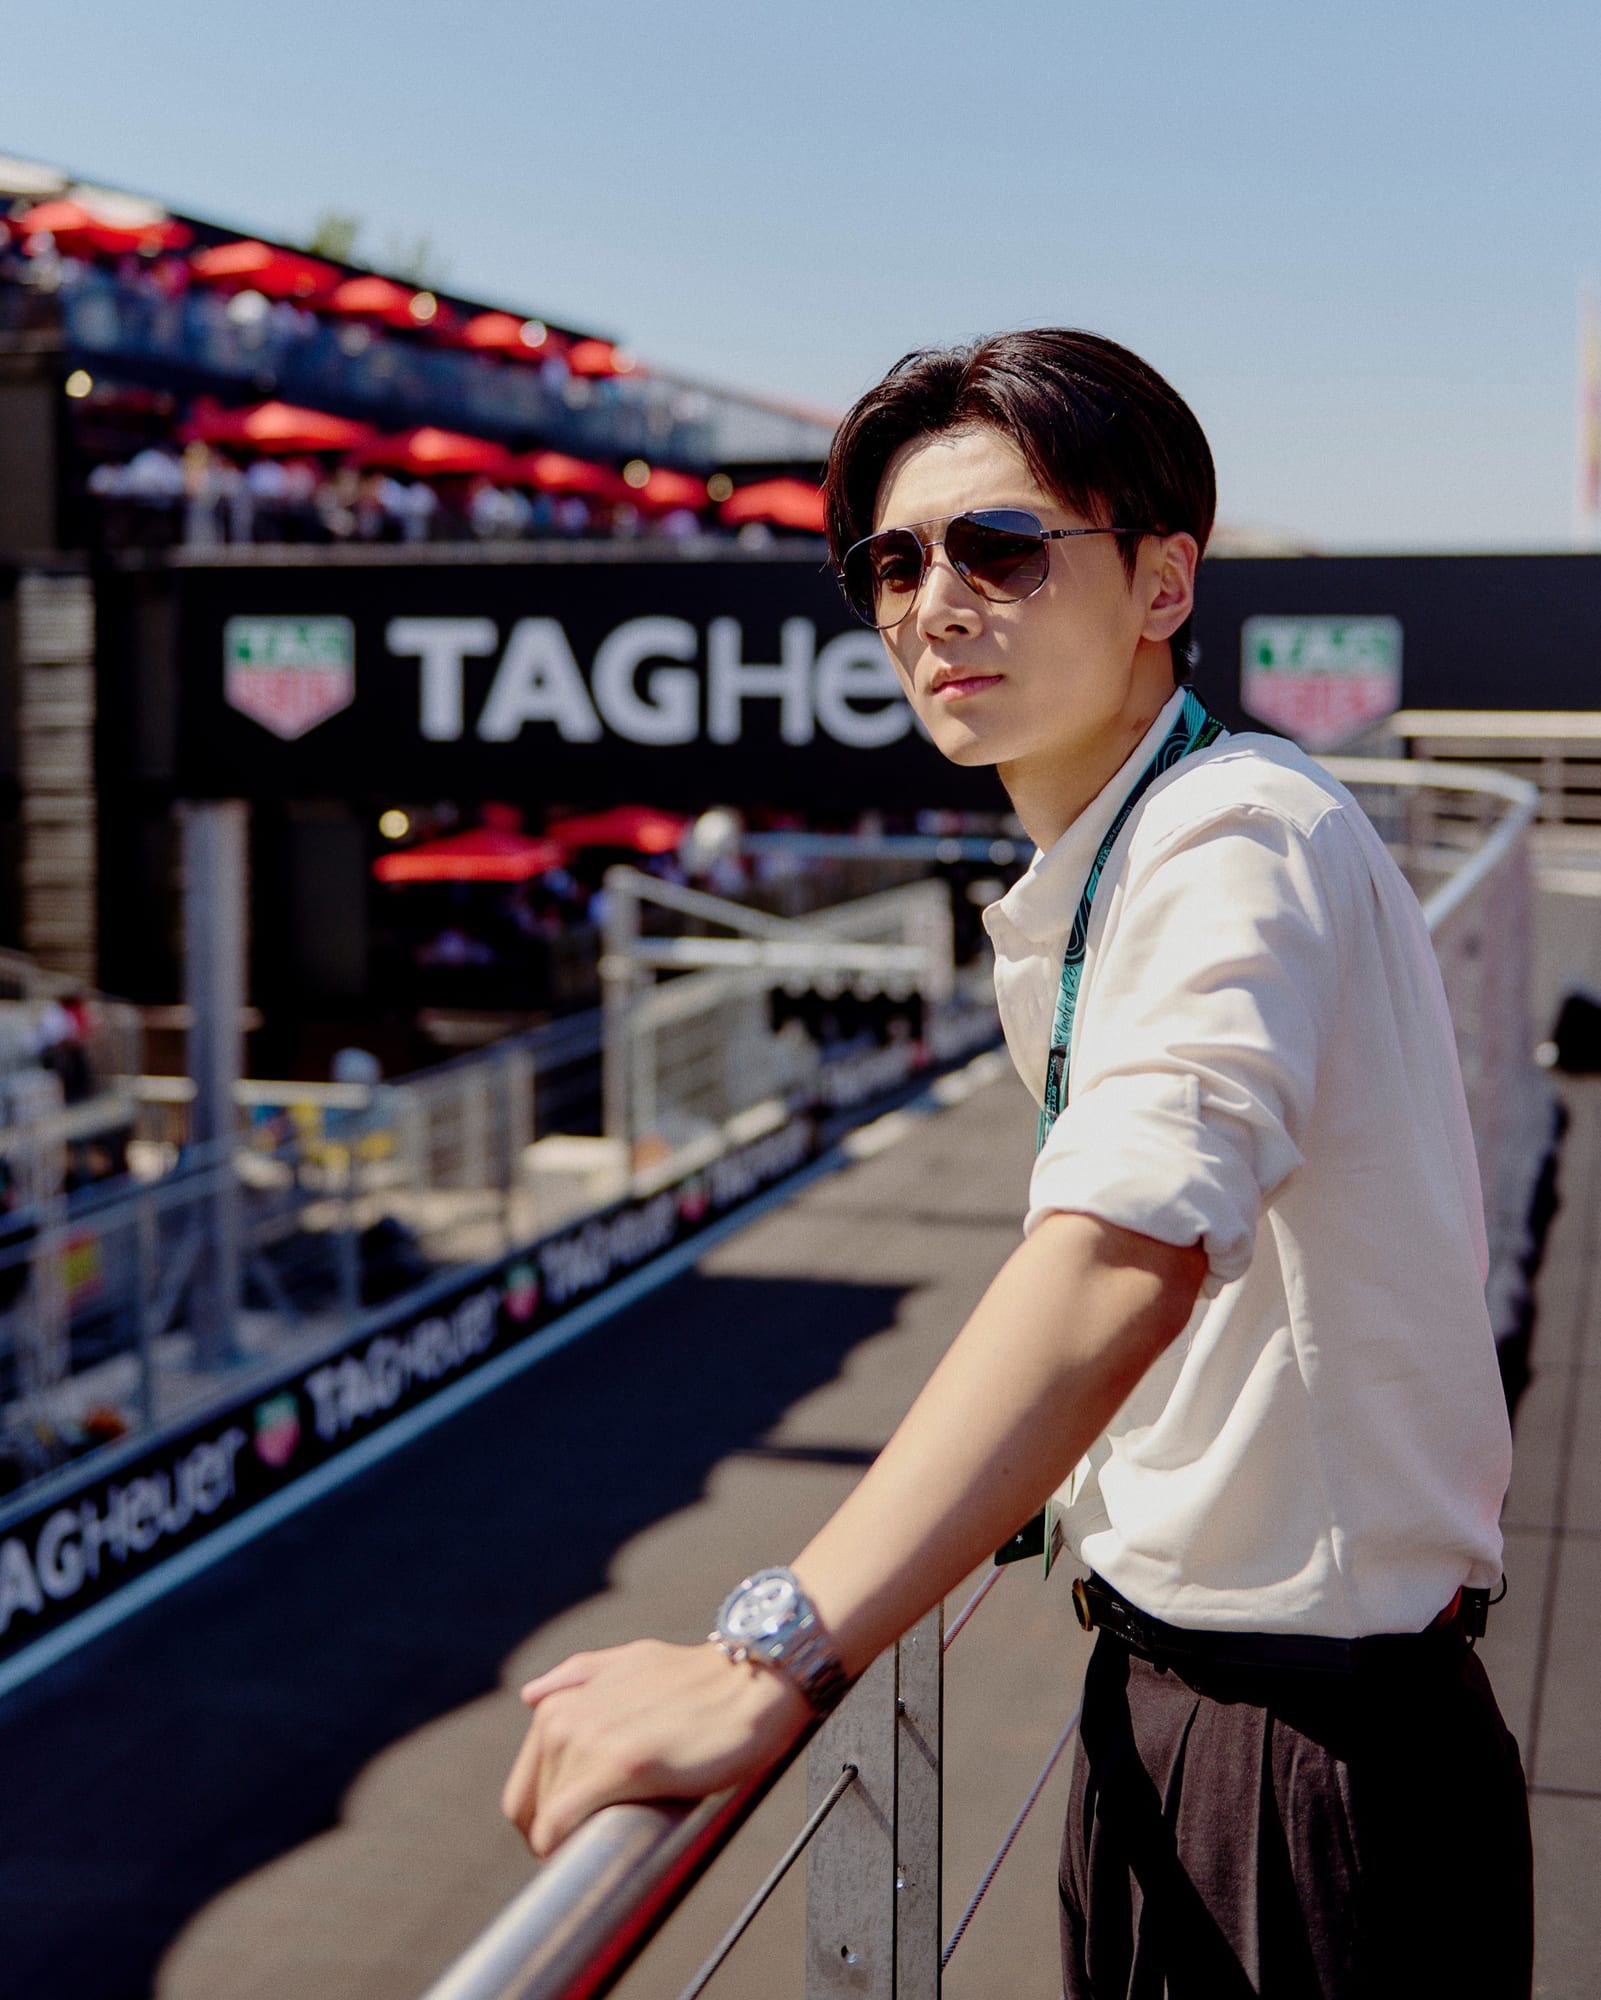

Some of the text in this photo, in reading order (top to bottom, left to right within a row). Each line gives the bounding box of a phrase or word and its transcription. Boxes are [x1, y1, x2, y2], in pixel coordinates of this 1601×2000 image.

[384, 615, 922, 748] TAGHe
[1054, 965, 1079, 1044] Madrid 26
[1046, 1056, 1057, 1113] PADDOCK
